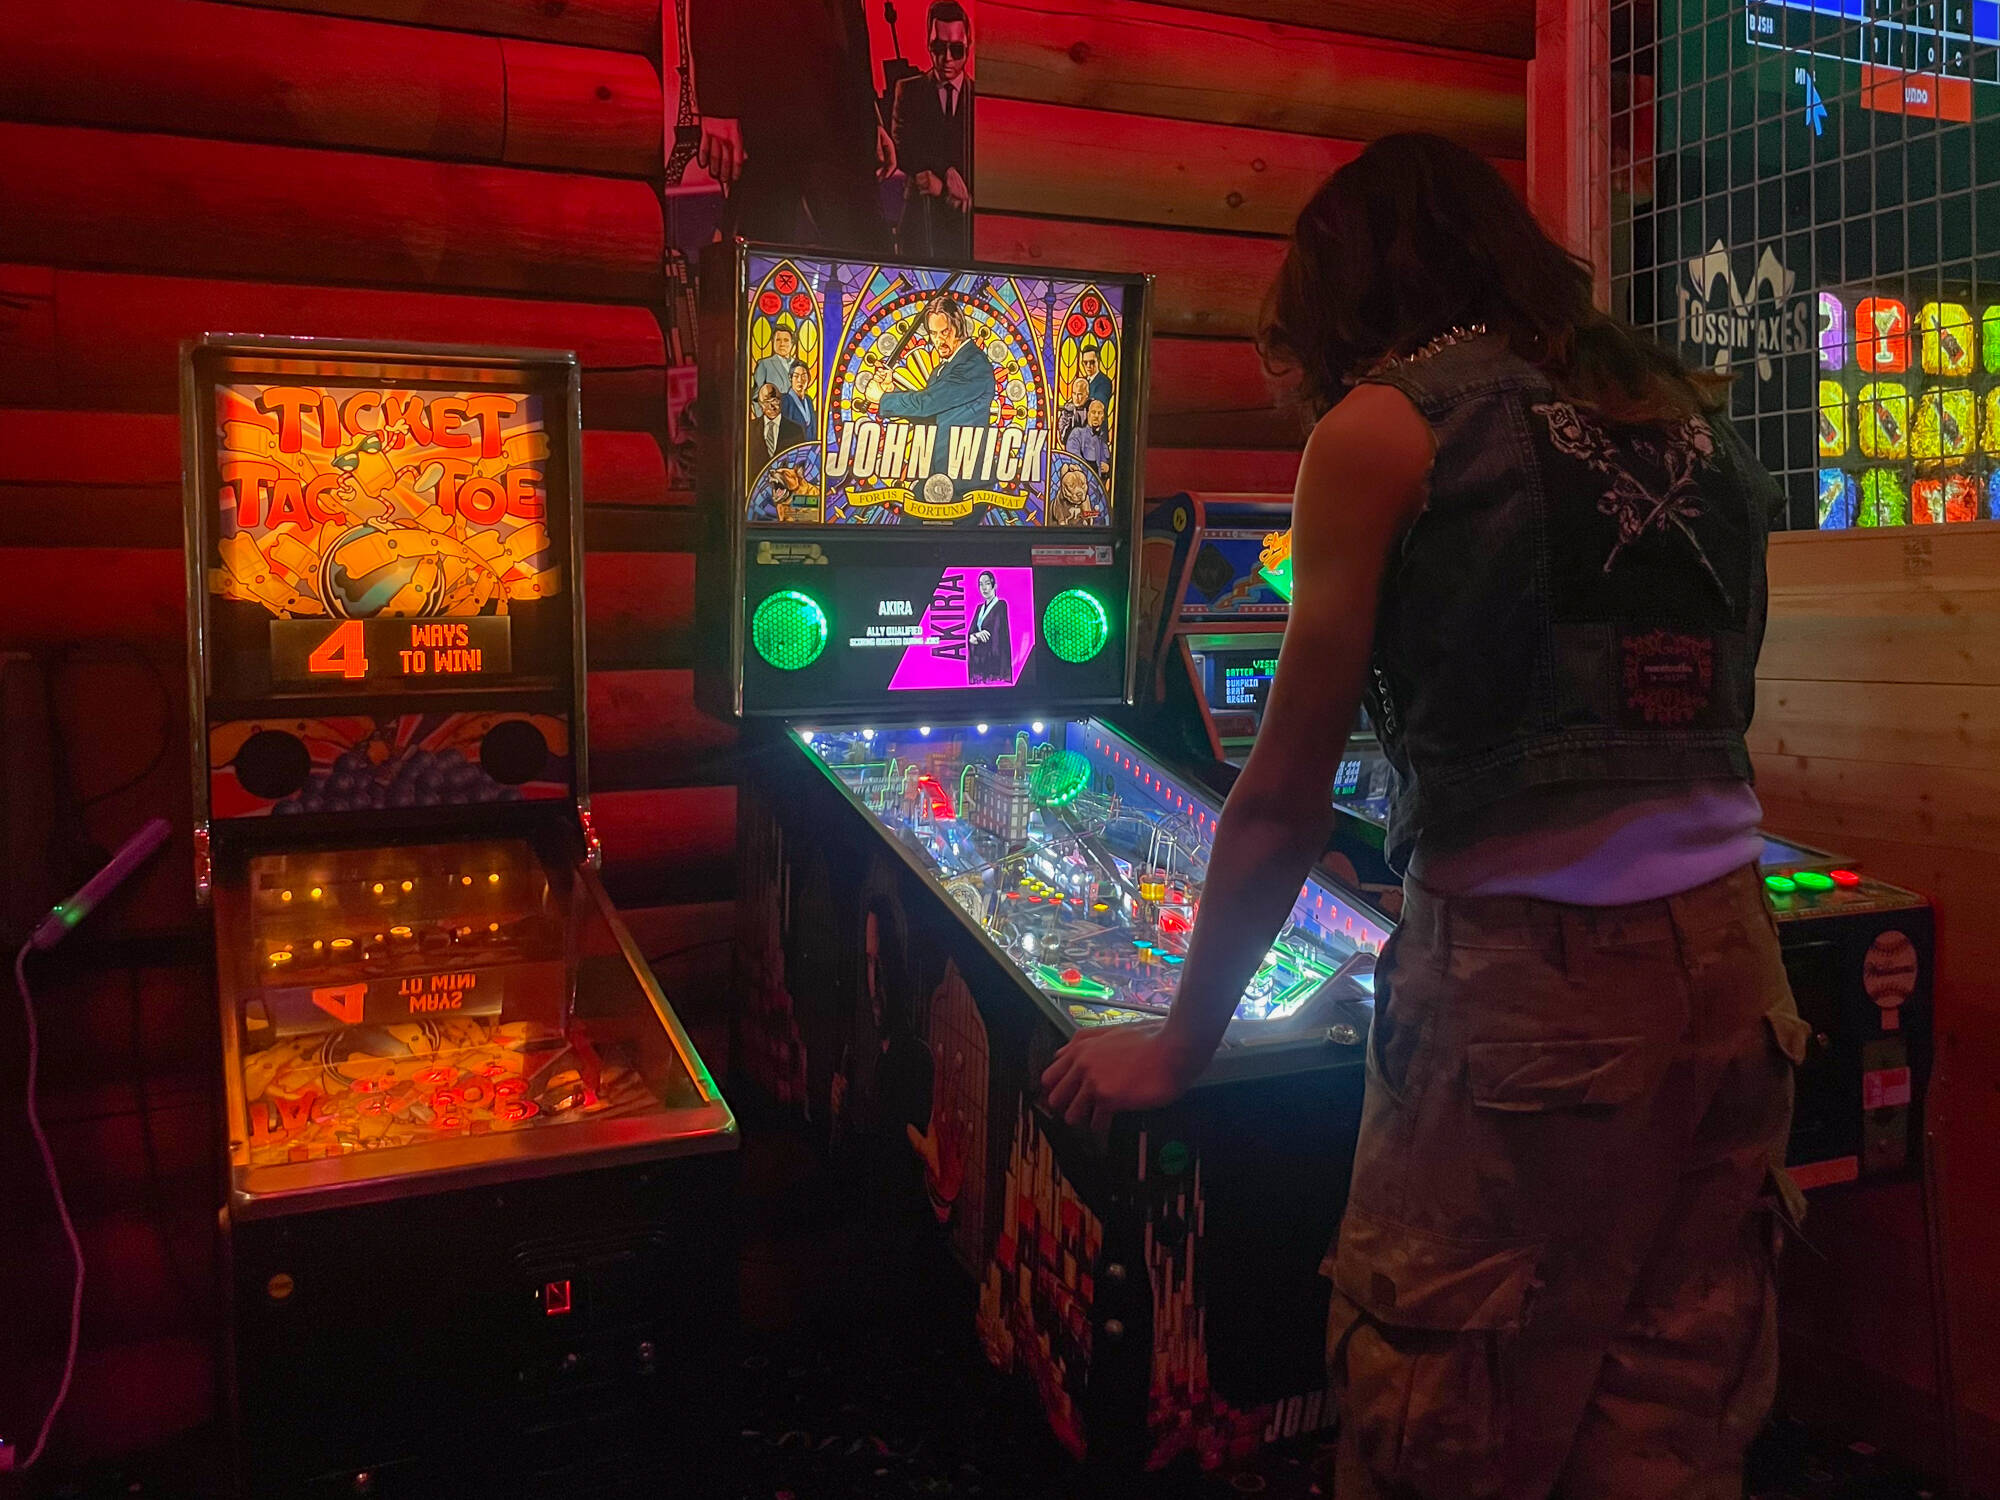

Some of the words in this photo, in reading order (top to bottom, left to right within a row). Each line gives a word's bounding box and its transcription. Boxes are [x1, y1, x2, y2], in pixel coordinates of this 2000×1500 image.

[258, 386, 517, 459] TICKET
[825, 421, 938, 479] JOHN
[946, 426, 1048, 482] WICK
[223, 460, 347, 531] TAC
[418, 457, 546, 526] TOE
[858, 490, 898, 504] FORTIS
[910, 502, 969, 517] FORTUNA
[878, 600, 913, 616] AKIRA
[929, 574, 967, 661] AKIRA
[308, 619, 369, 679] 4
[411, 624, 469, 647] WAYS
[866, 626, 885, 637] ALLY
[399, 650, 427, 674] TO
[434, 649, 482, 672] WIN!
